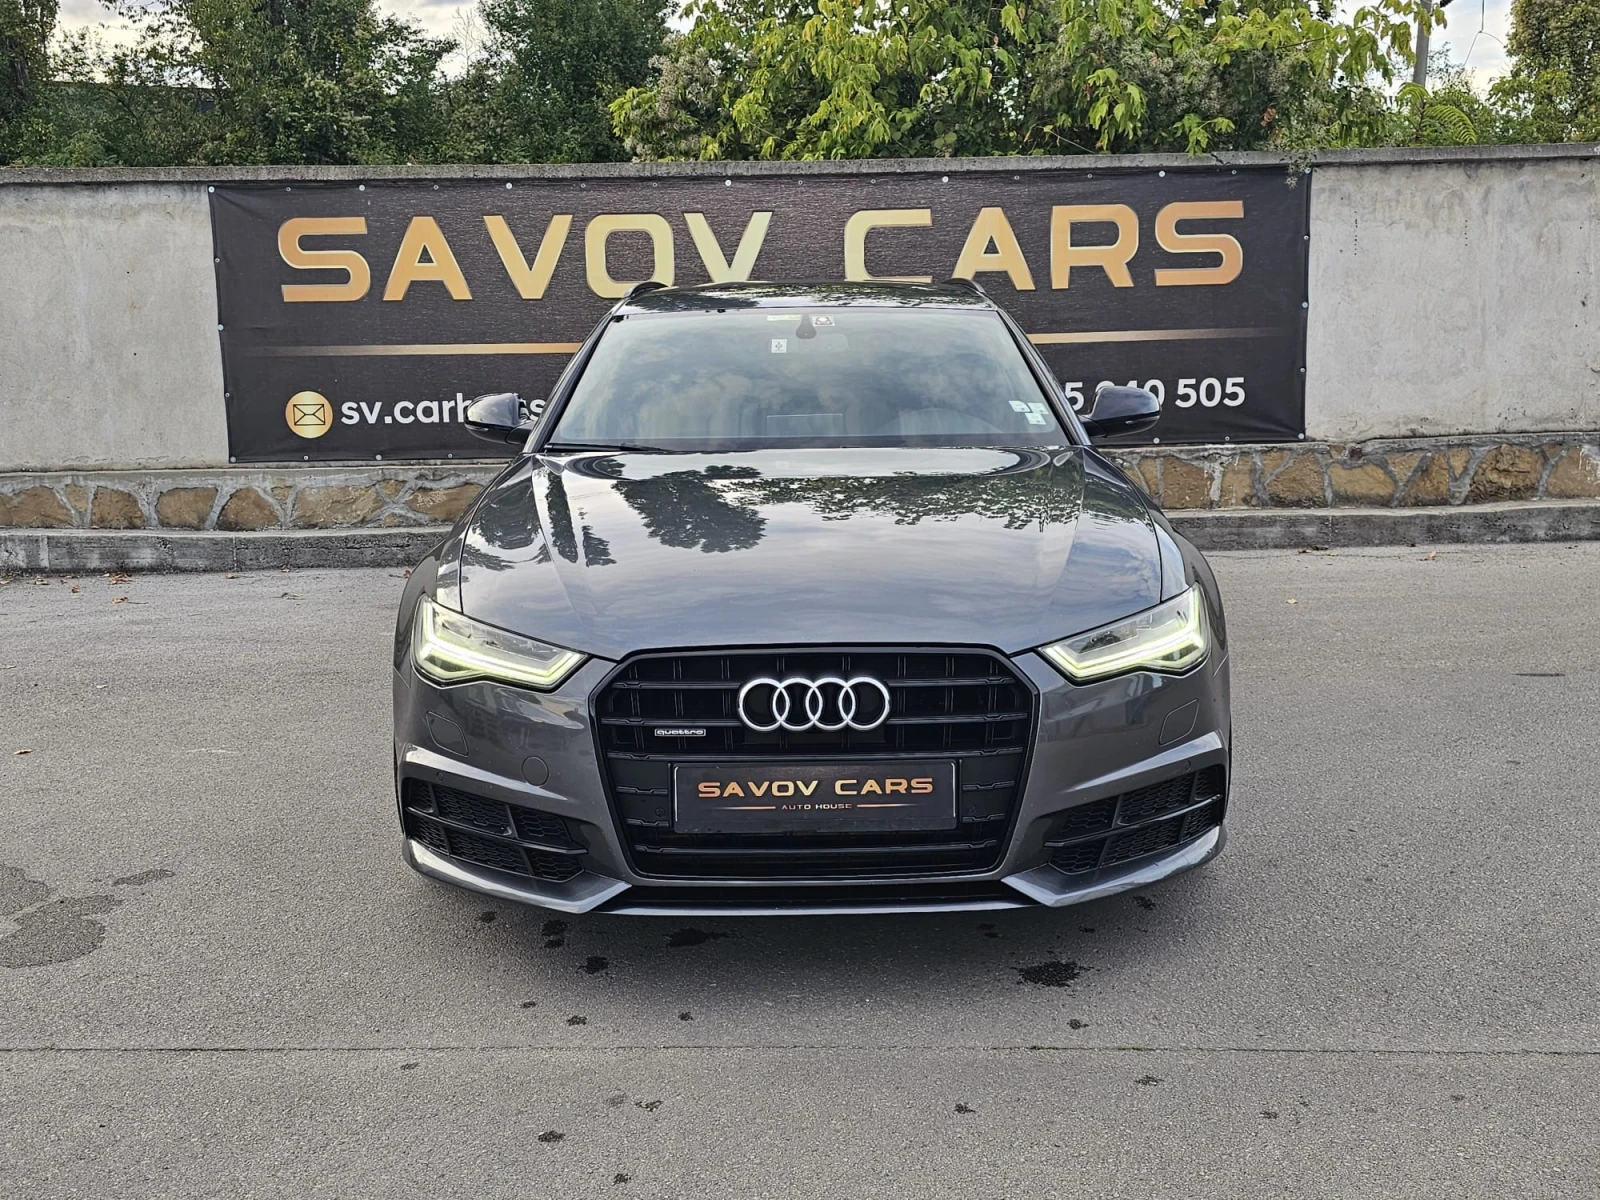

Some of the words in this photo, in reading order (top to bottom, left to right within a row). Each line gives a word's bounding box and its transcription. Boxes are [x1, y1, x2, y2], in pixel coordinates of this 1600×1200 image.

[277, 210, 773, 302] SAVOV
[843, 200, 1244, 291] CARS
[1174, 376, 1246, 408] 505
[340, 392, 547, 425] sv.carhs
[698, 780, 819, 798] SAVOV
[834, 777, 934, 795] CARS
